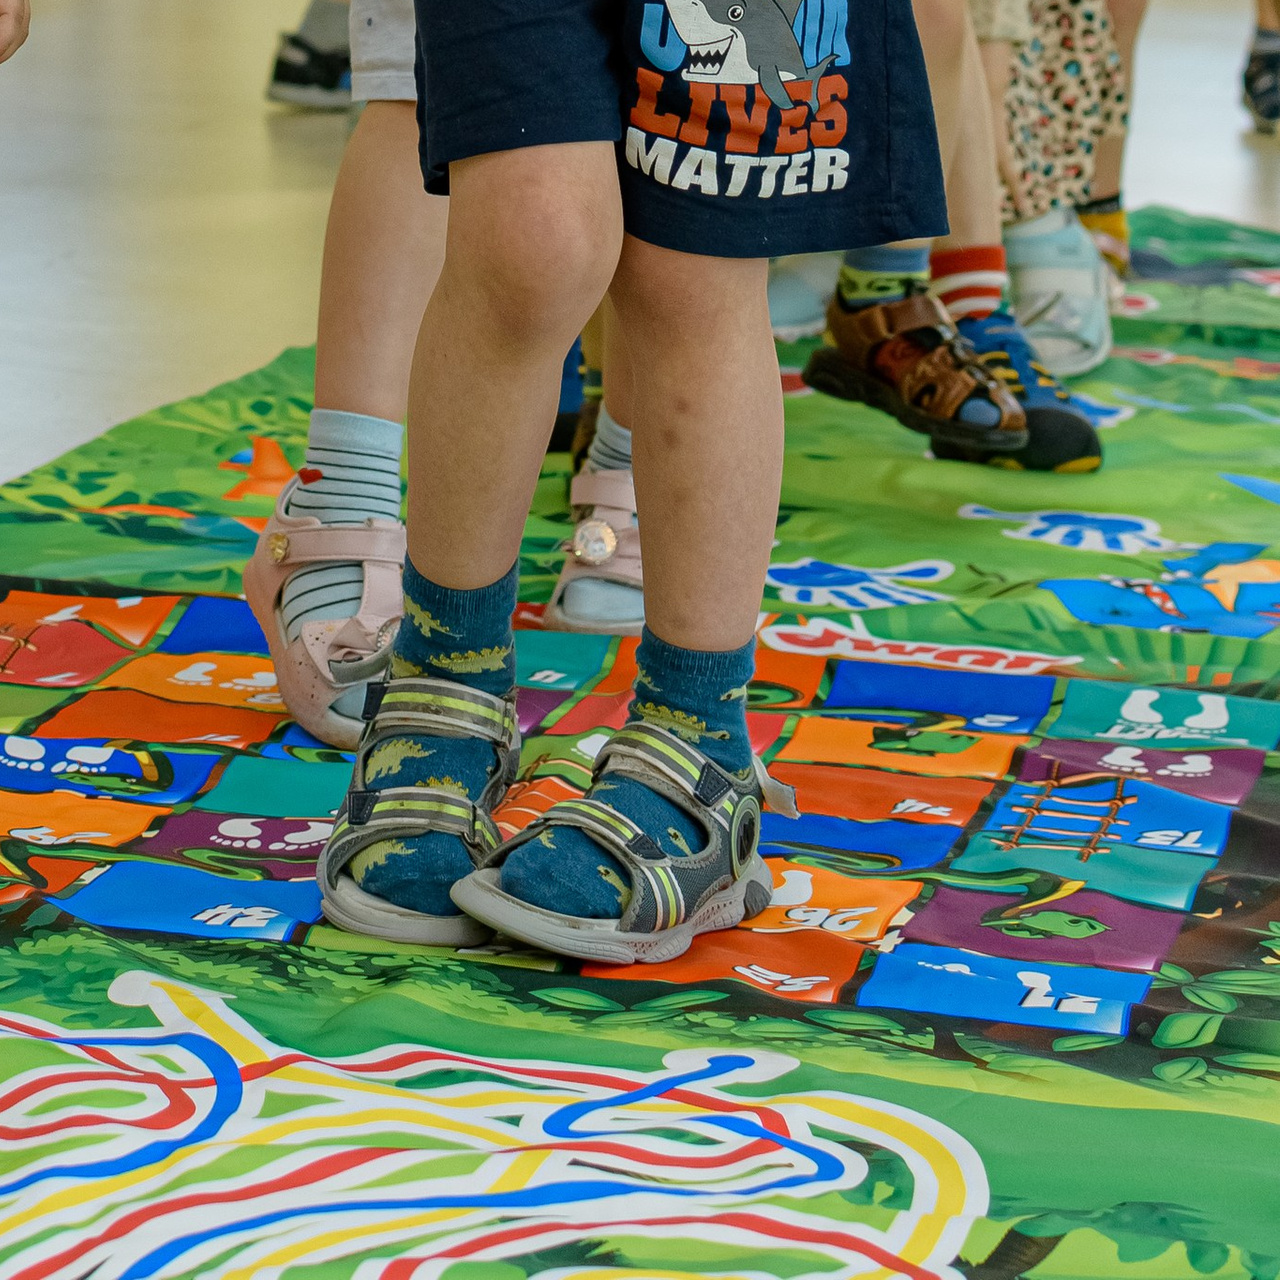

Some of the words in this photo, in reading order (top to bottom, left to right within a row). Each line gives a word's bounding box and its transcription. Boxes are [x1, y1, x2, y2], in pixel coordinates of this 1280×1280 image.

[630, 66, 850, 154] LIVES
[626, 126, 850, 198] MATTER
[1138, 830, 1202, 848] 13
[779, 906, 877, 932] 26
